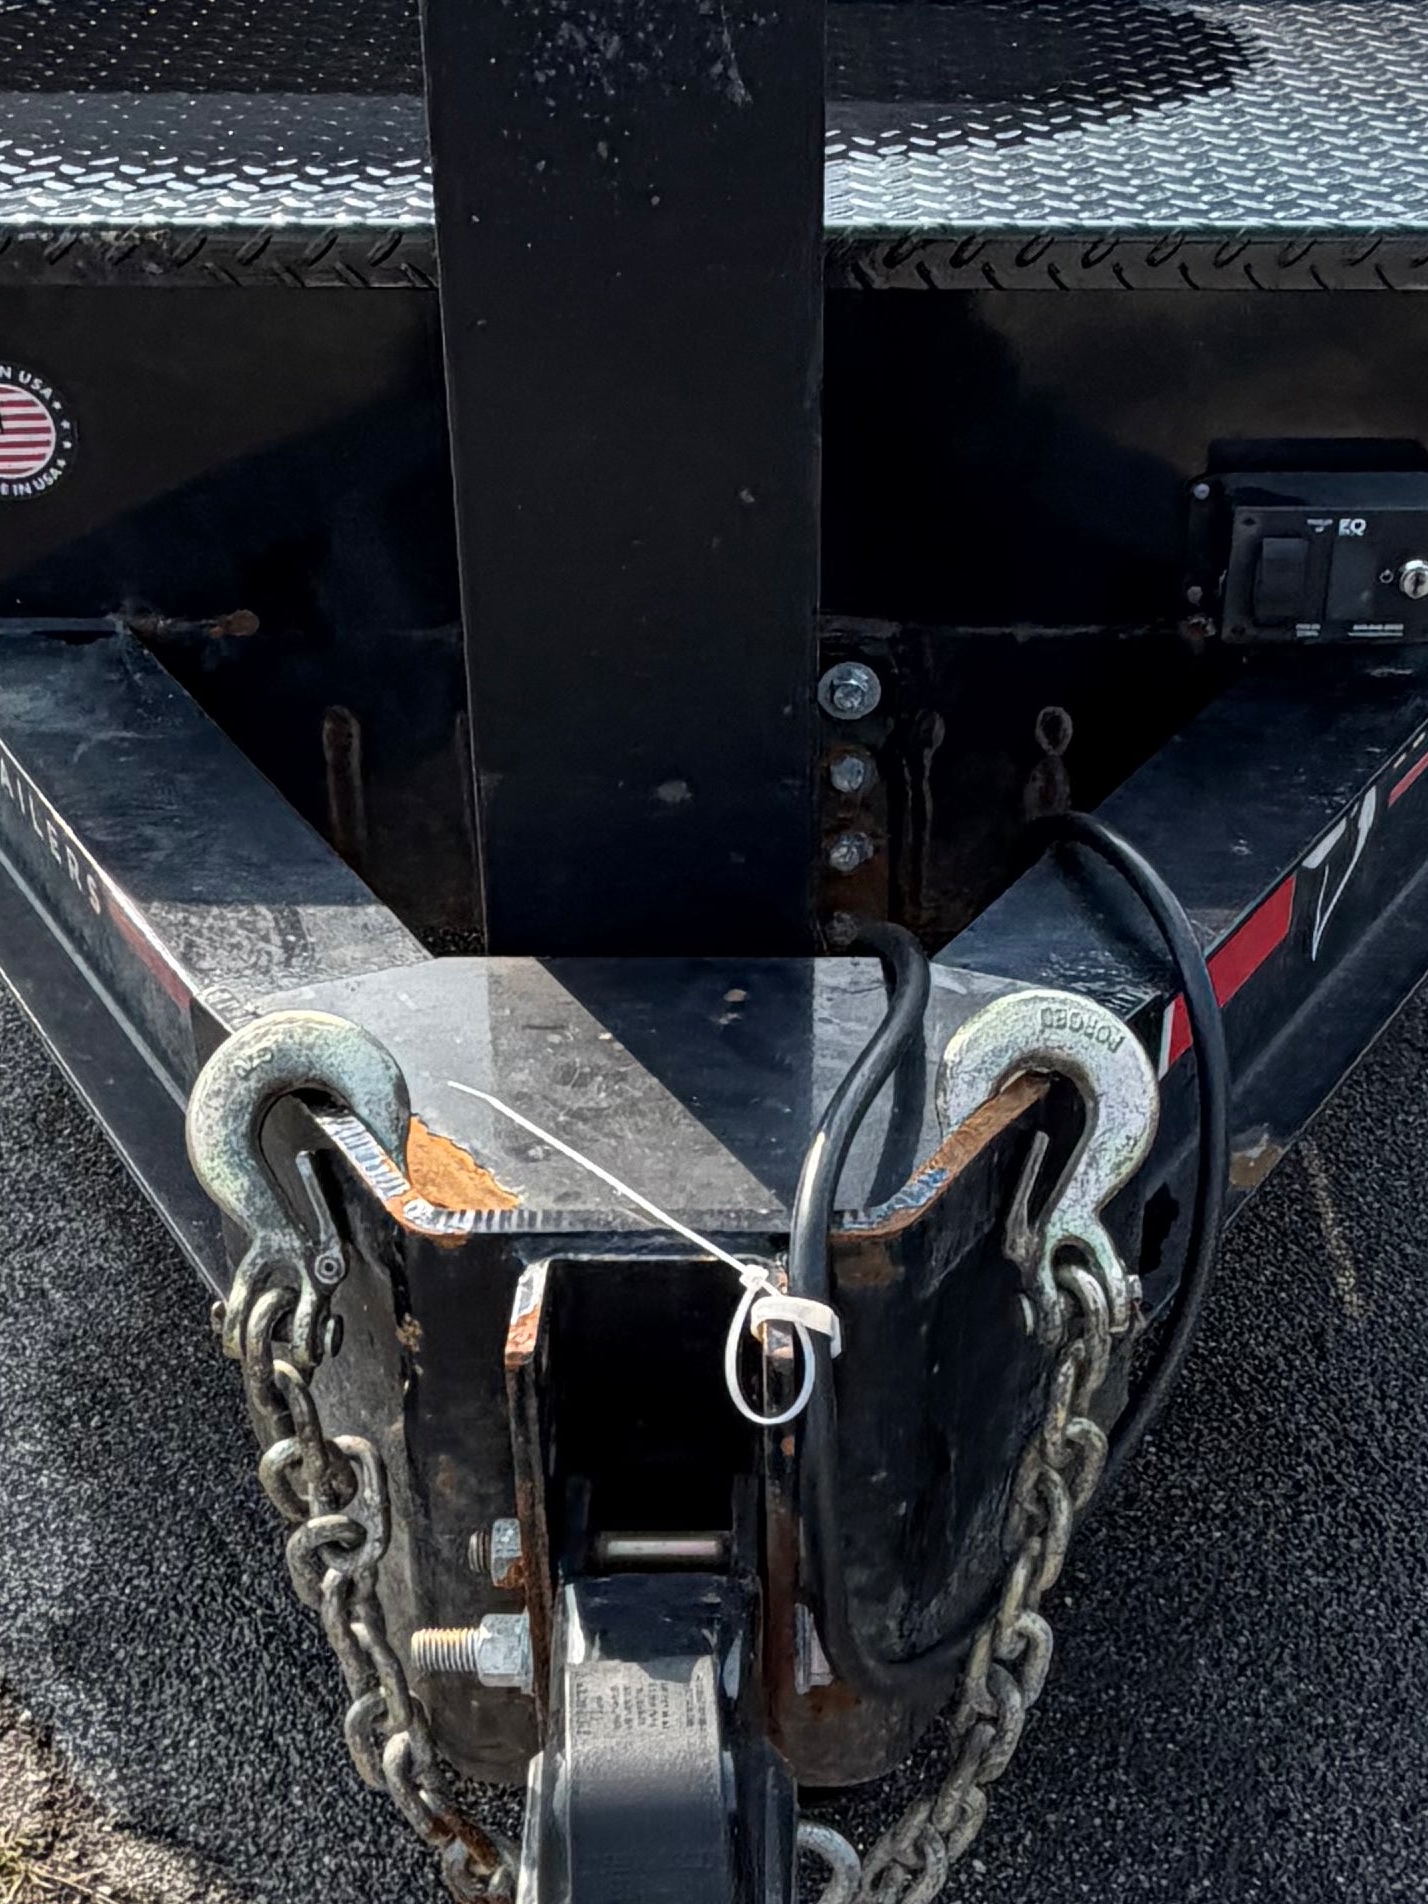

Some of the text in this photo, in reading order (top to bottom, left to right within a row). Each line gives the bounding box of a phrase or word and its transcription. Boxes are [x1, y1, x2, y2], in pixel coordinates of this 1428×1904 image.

[18, 370, 53, 400] USA
[12, 484, 33, 496] IN
[32, 467, 63, 491] USA
[1338, 518, 1367, 536] EQ
[1039, 1006, 1126, 1054] FORGED
